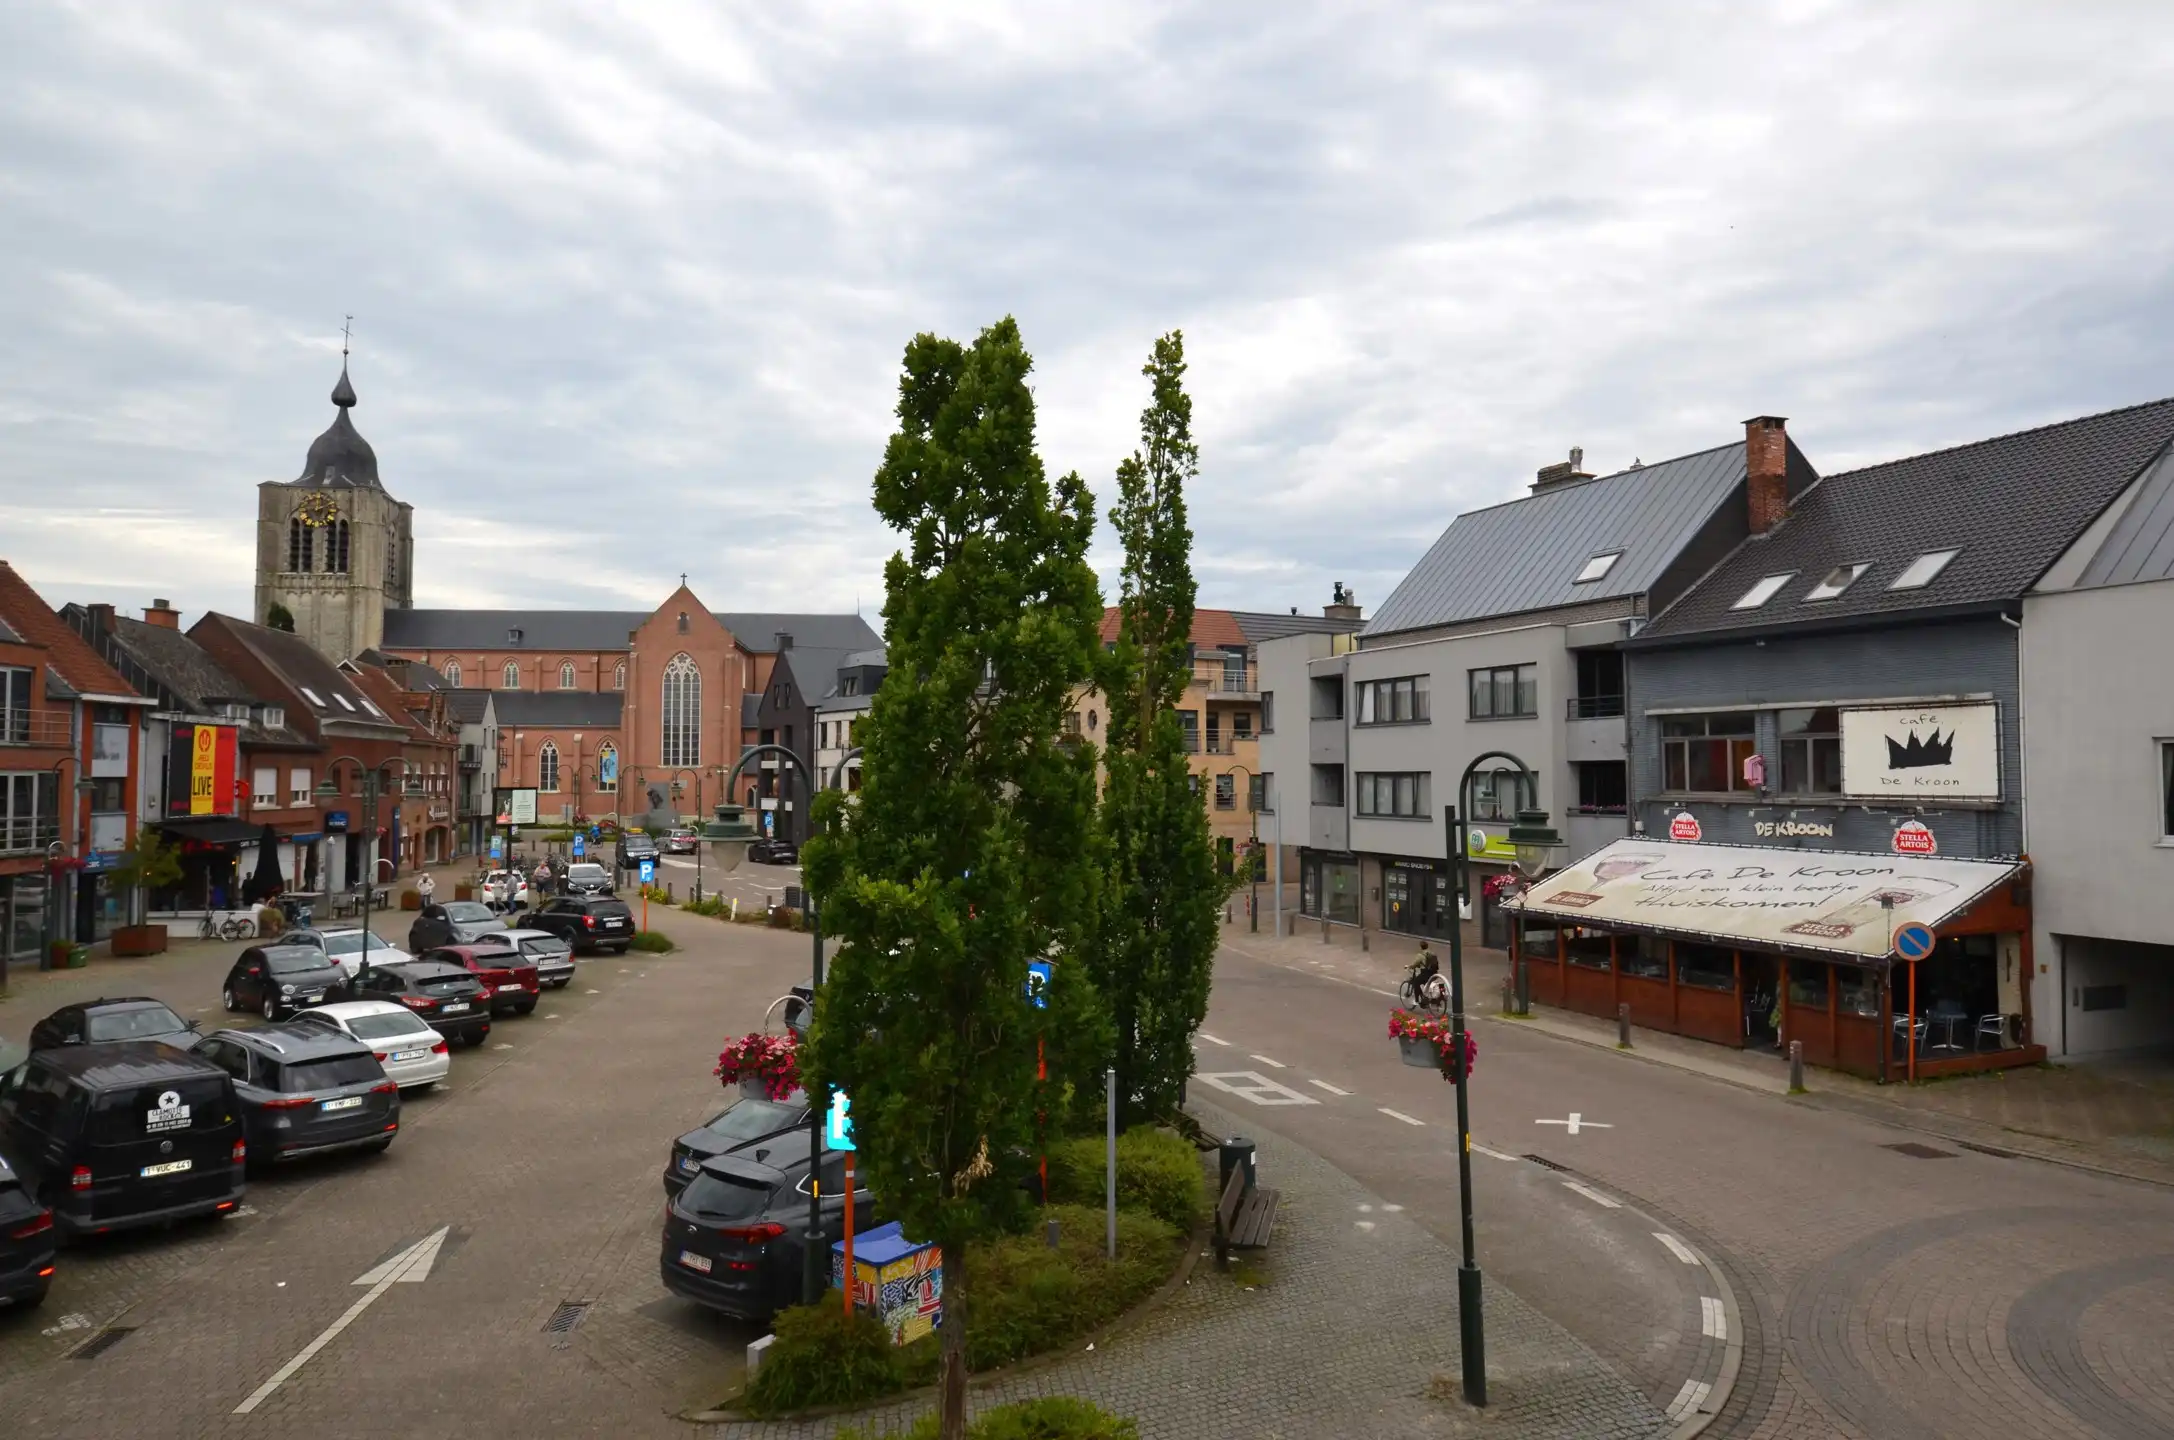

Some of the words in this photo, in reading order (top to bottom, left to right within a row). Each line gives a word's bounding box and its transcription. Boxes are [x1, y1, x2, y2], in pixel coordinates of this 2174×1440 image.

[192, 776, 212, 796] LIVE
[1879, 776, 1901, 785] De
[1914, 776, 1960, 786] Kroon
[1674, 823, 1695, 831] STELLA
[1754, 821, 1773, 836] DE
[1775, 821, 1834, 837] KROON
[574, 835, 584, 847] P
[1899, 834, 1928, 842] STELLA
[1899, 841, 1929, 849] ARTOIS
[641, 863, 653, 880] P
[1727, 866, 1775, 880] De
[1789, 865, 1895, 879] Kroon
[1738, 882, 1783, 892] klein
[1792, 882, 1859, 896] beetje
